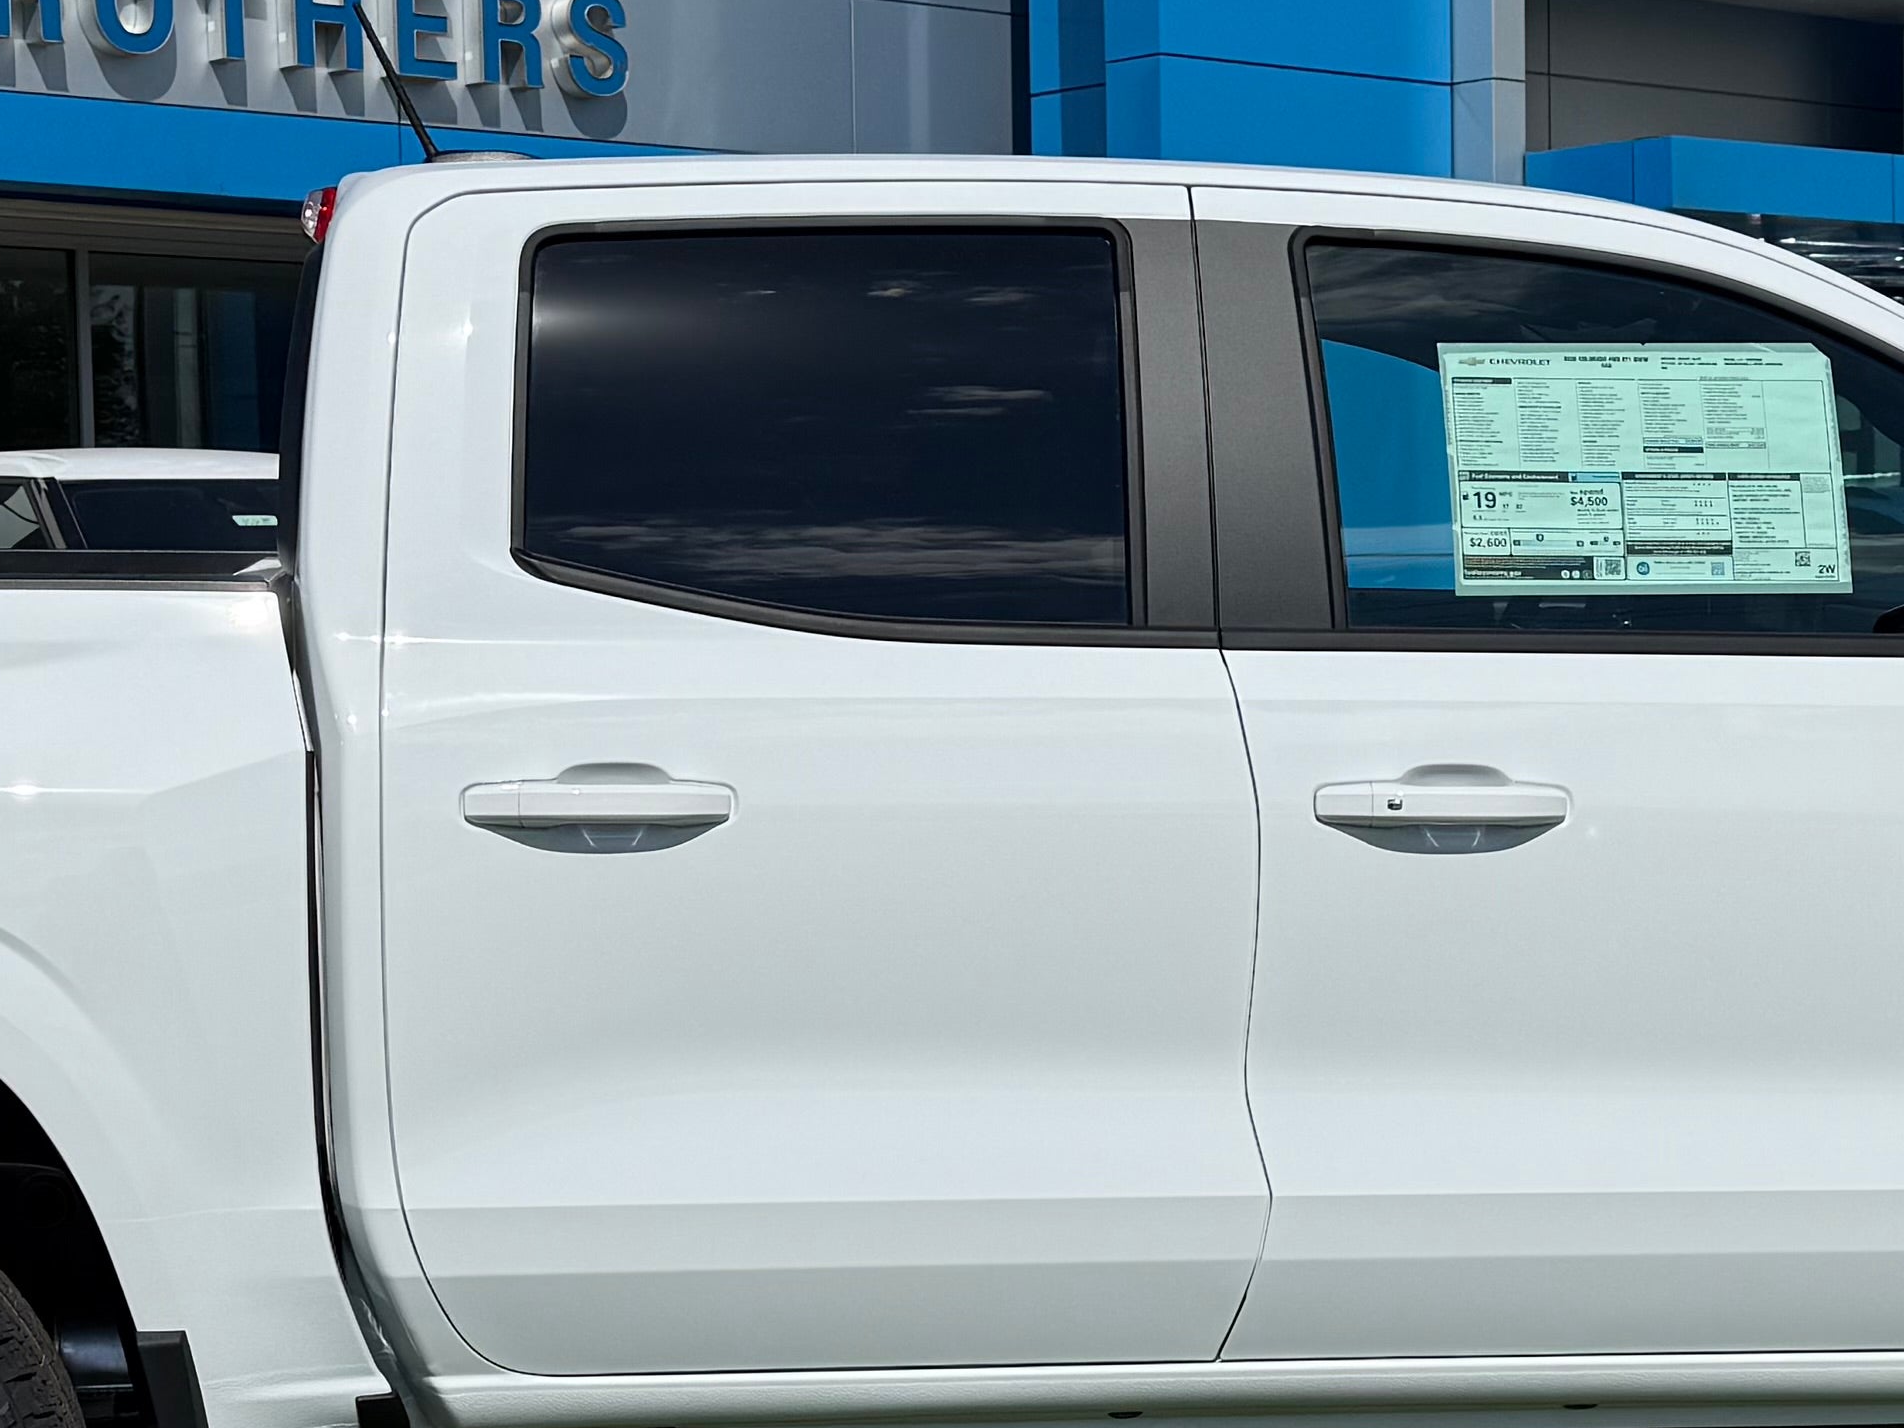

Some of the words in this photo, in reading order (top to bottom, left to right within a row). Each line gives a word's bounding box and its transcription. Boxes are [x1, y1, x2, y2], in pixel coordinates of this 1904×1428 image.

[1489, 357, 1551, 367] CHEVROLET
[1472, 491, 1497, 510] 19
[1570, 496, 1608, 507] $4,500
